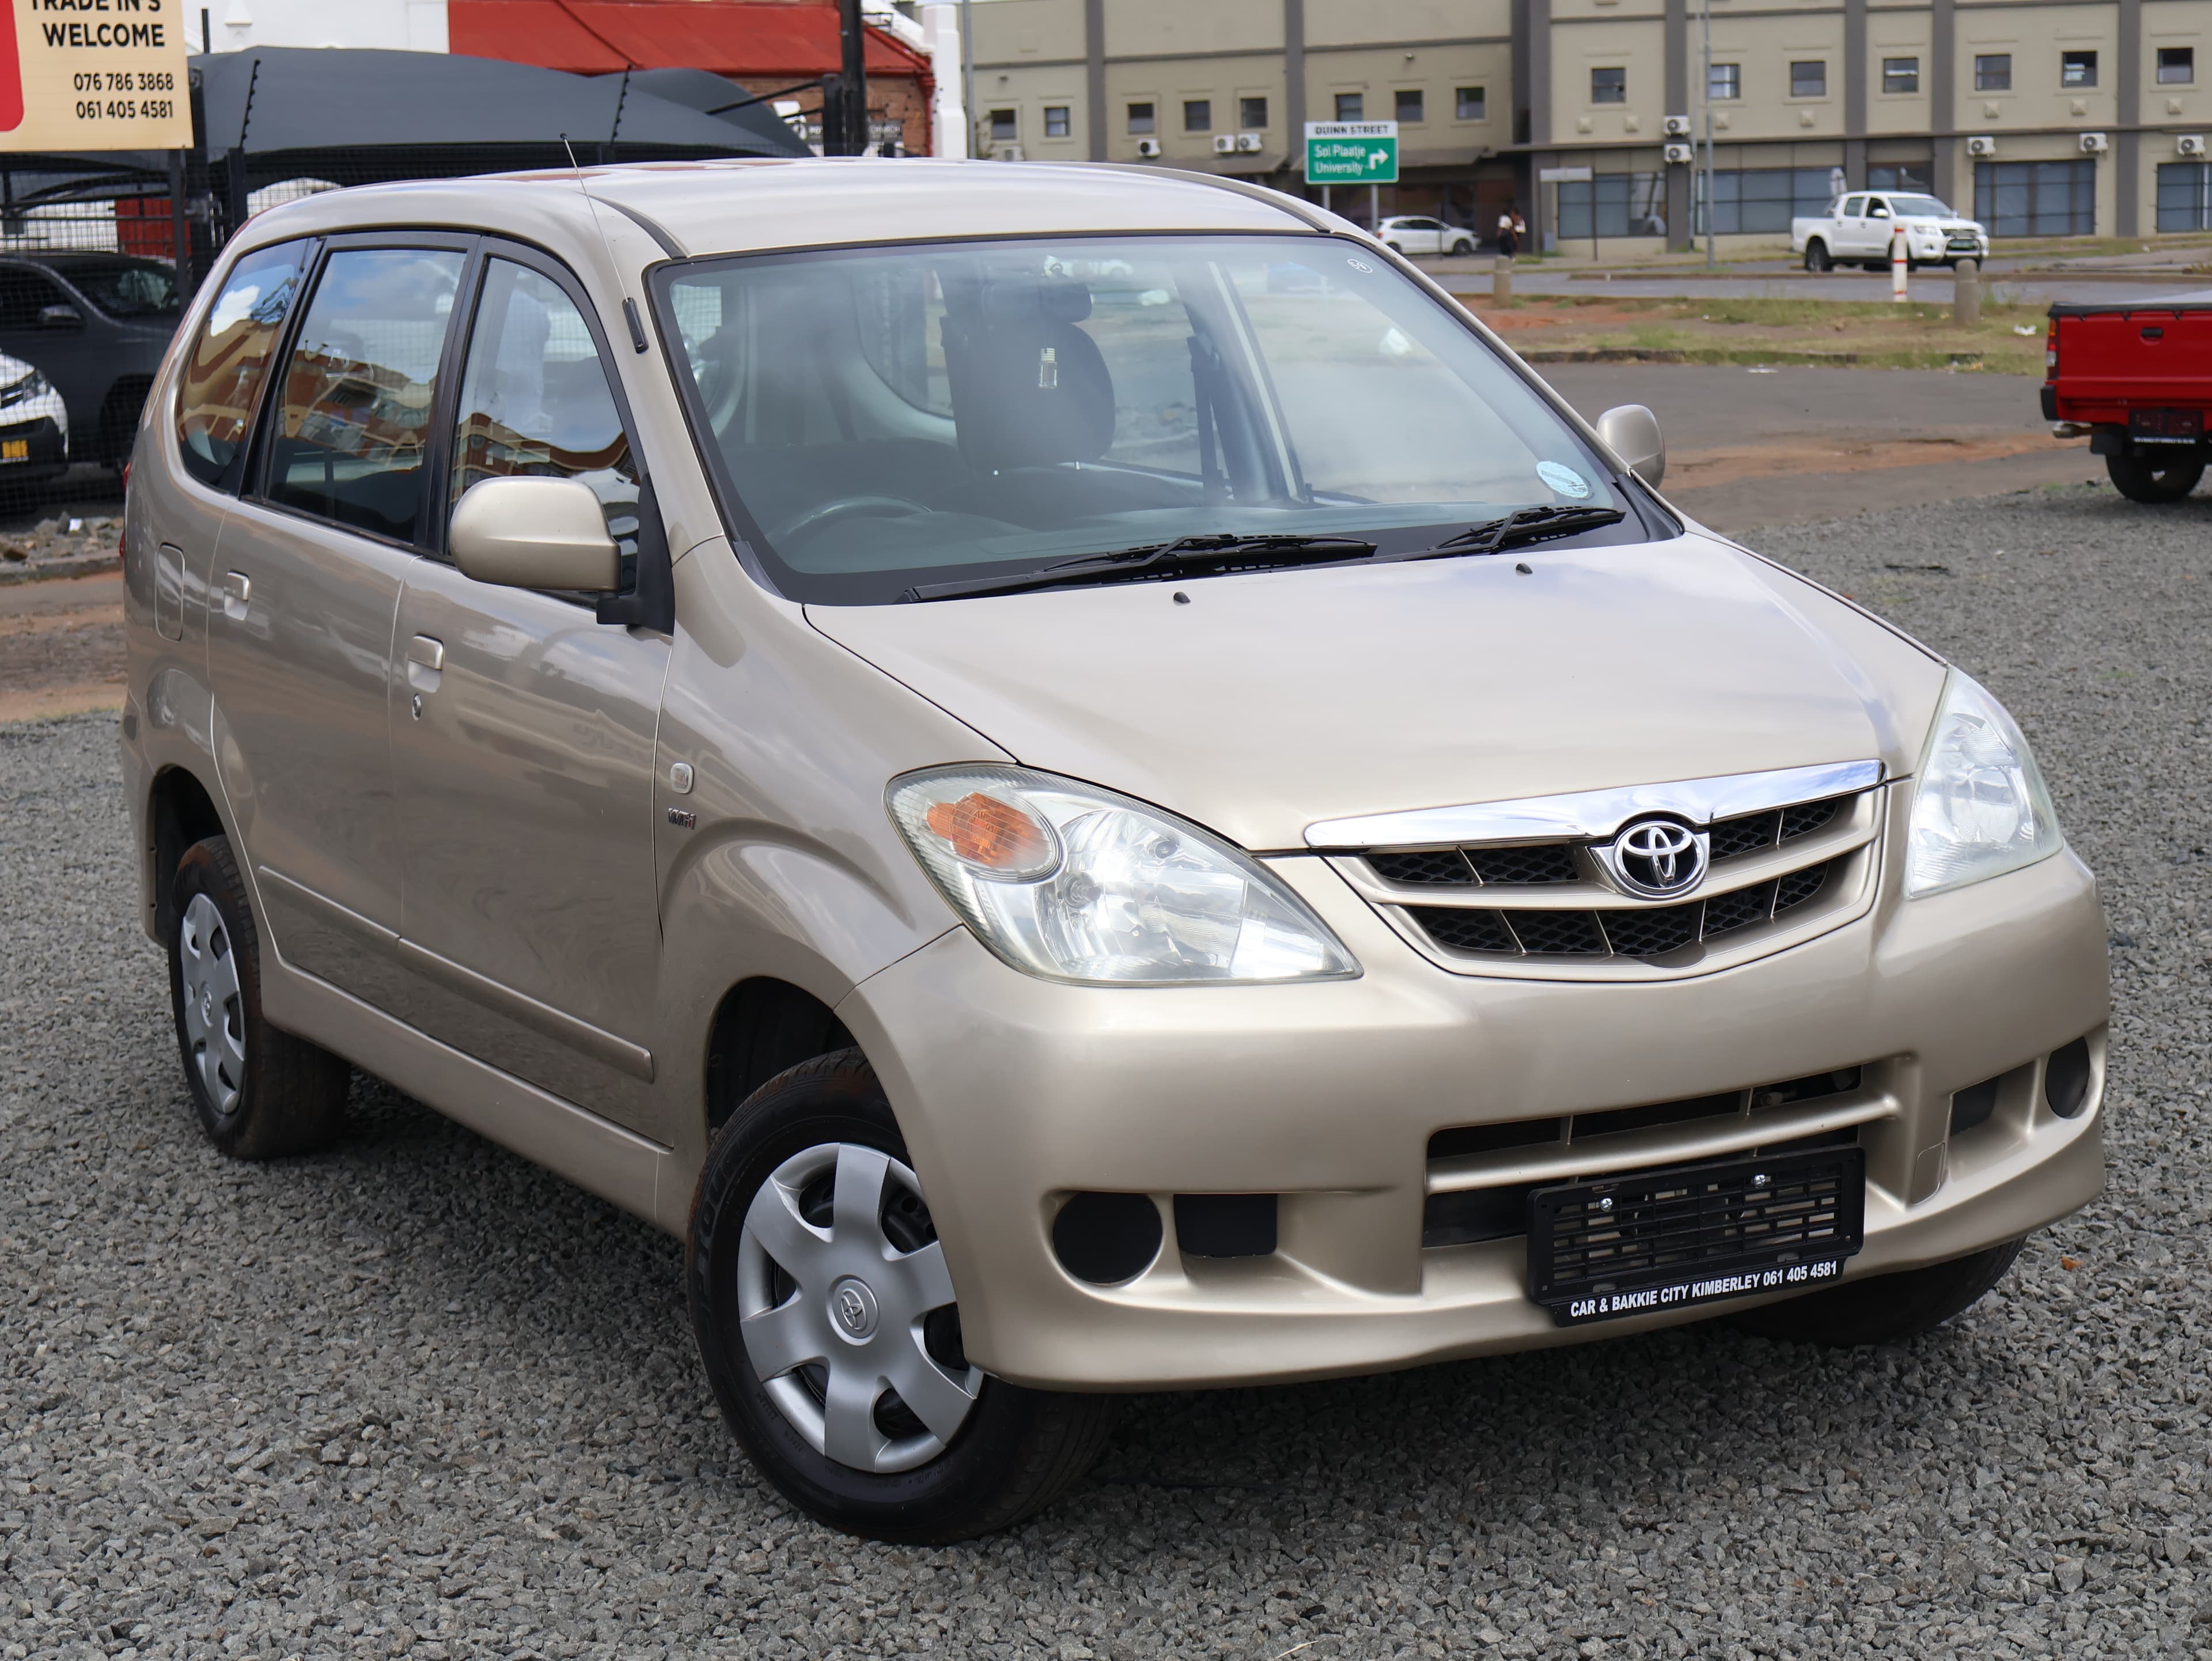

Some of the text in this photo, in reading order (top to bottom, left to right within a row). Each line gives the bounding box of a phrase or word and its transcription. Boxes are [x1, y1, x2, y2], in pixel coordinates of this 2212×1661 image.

[41, 23, 165, 47] WELCOME
[74, 73, 174, 91] 076 786 3868
[76, 100, 173, 119] 061 405 4581
[1350, 125, 1388, 134] STREET
[1314, 144, 1366, 160] Sol Plaatje
[1315, 161, 1363, 176] University
[1571, 1261, 1836, 1317] CAR & BAKKIE CITY KIMBERLEY 061 405 4581
